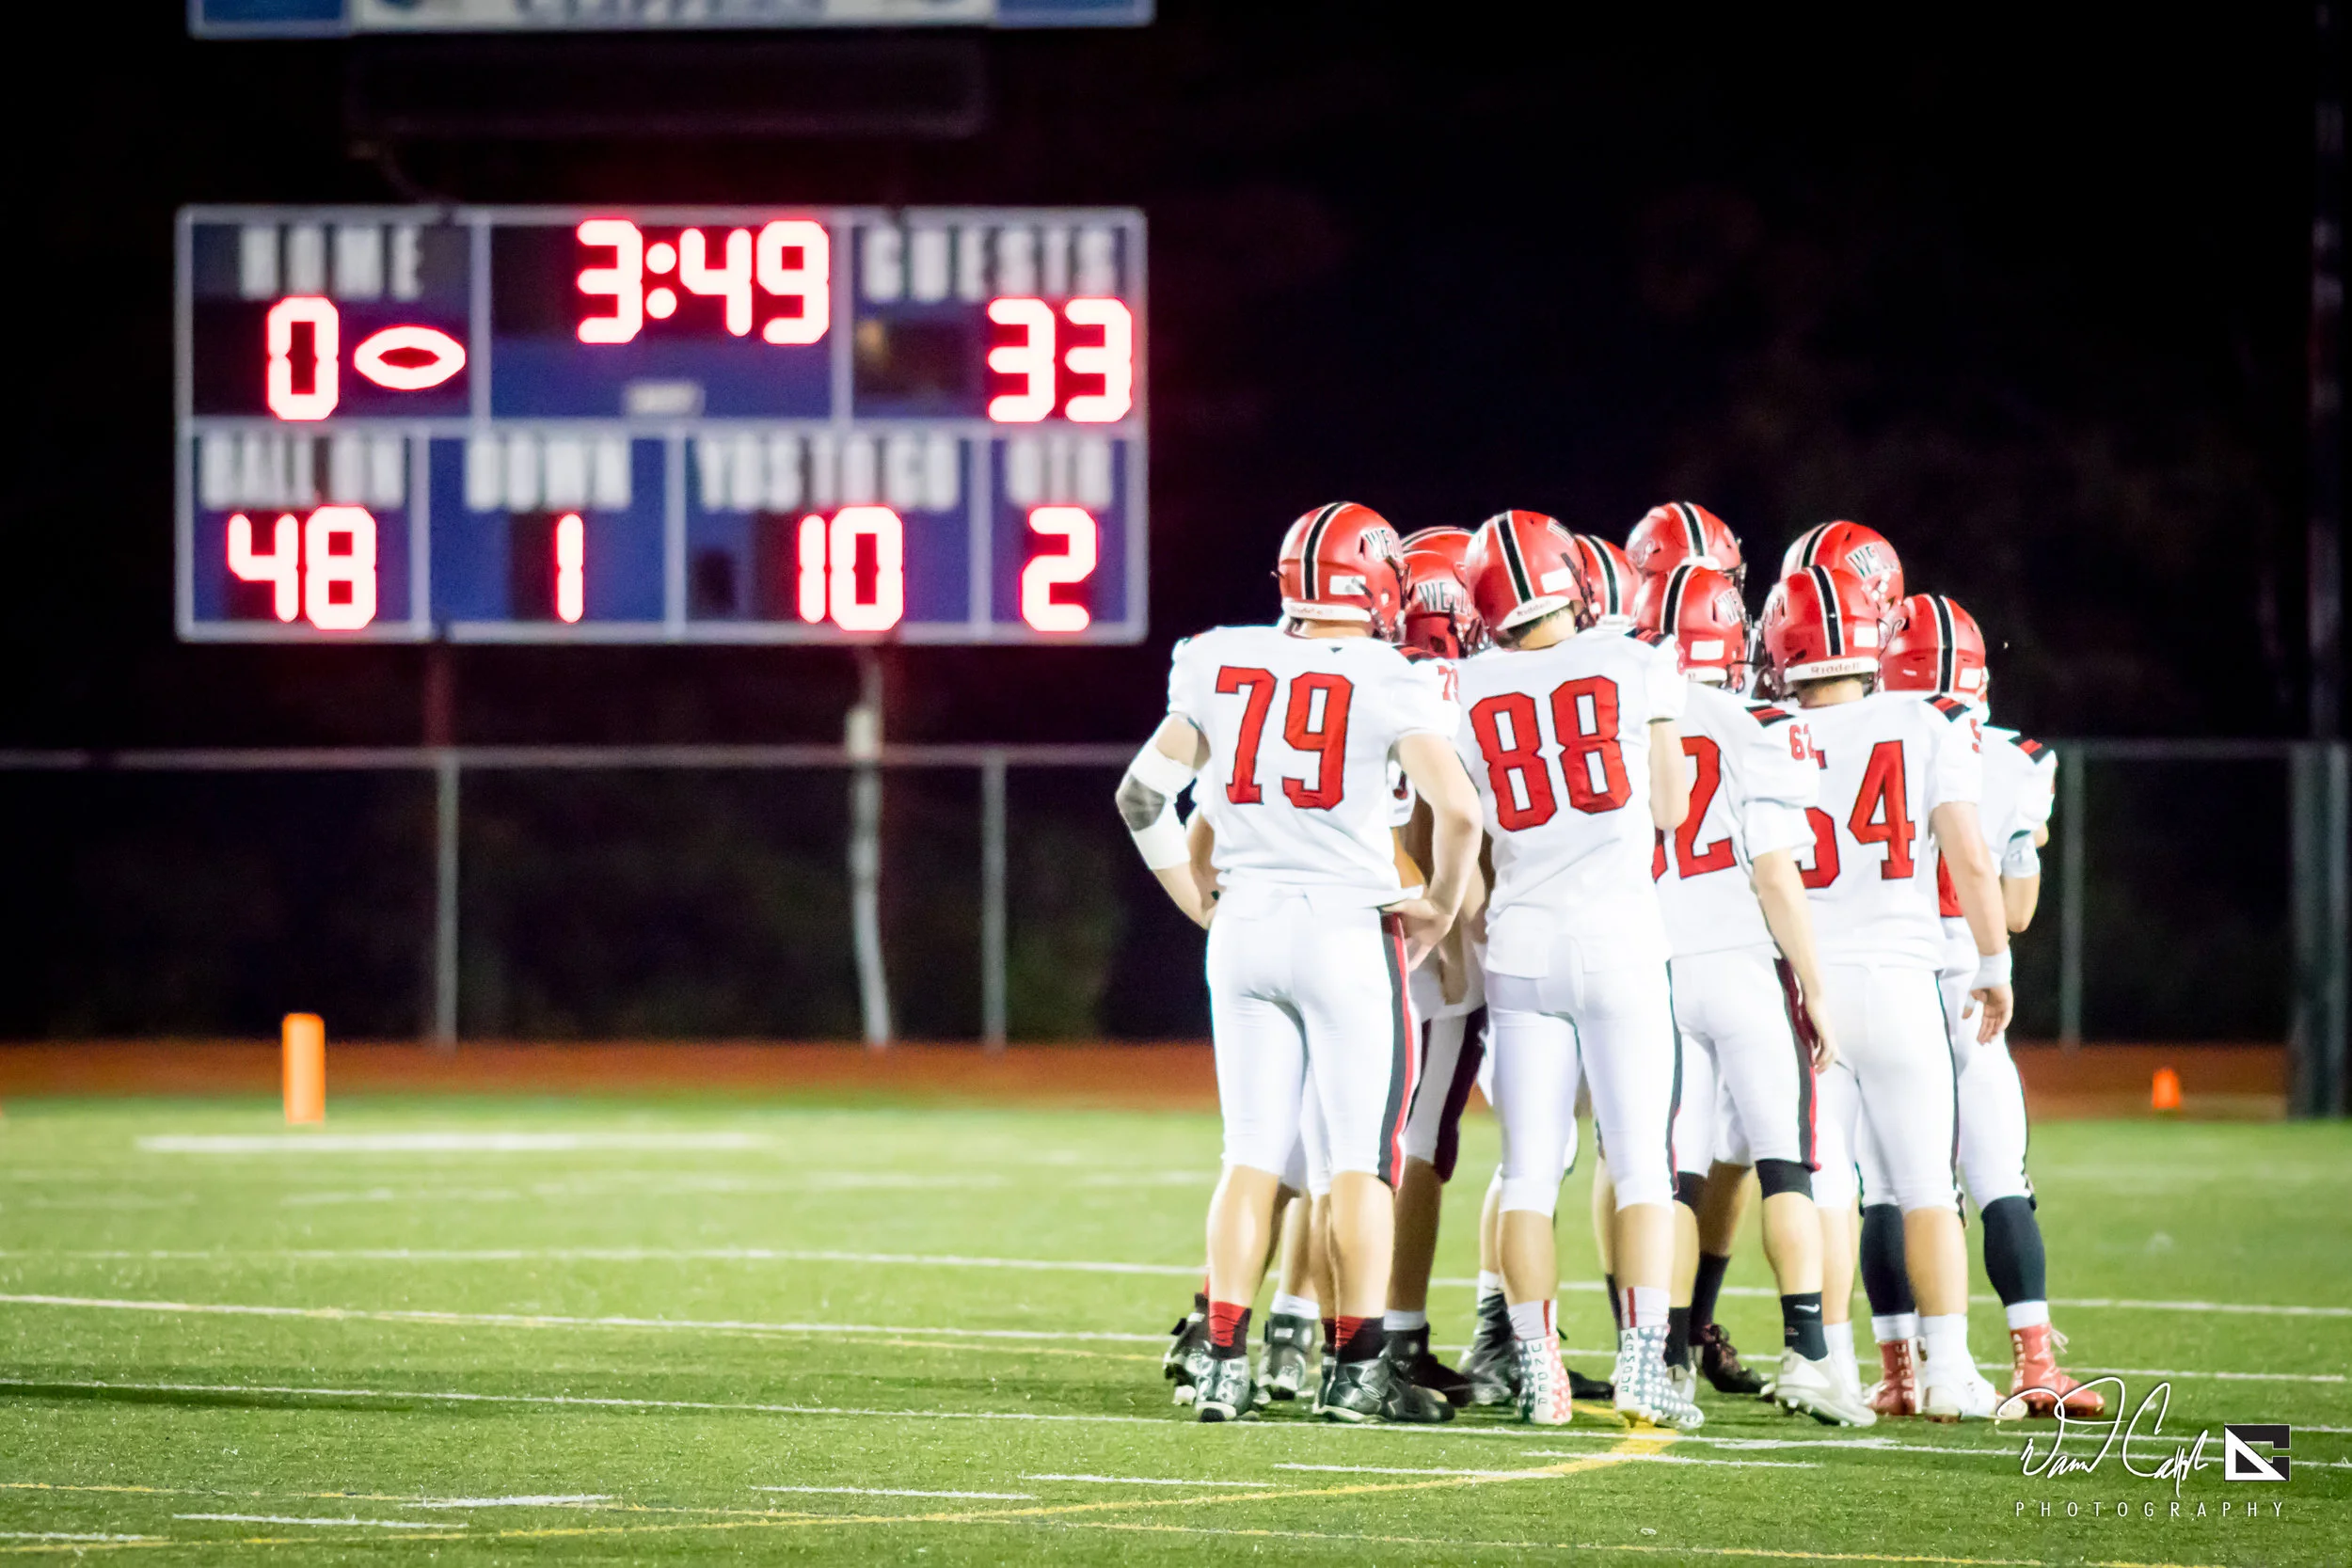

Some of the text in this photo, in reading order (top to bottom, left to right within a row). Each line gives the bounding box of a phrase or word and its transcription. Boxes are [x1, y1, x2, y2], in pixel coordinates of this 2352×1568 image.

[576, 219, 830, 345] 3:49
[266, 295, 340, 420] 0
[987, 297, 1132, 423] 33
[227, 504, 376, 630] 48
[556, 513, 584, 624] 1
[799, 504, 904, 631] 10
[1021, 505, 1098, 632] 2
[1216, 664, 1354, 812] 79
[1469, 674, 1632, 832] 88
[1651, 735, 1738, 884] 2
